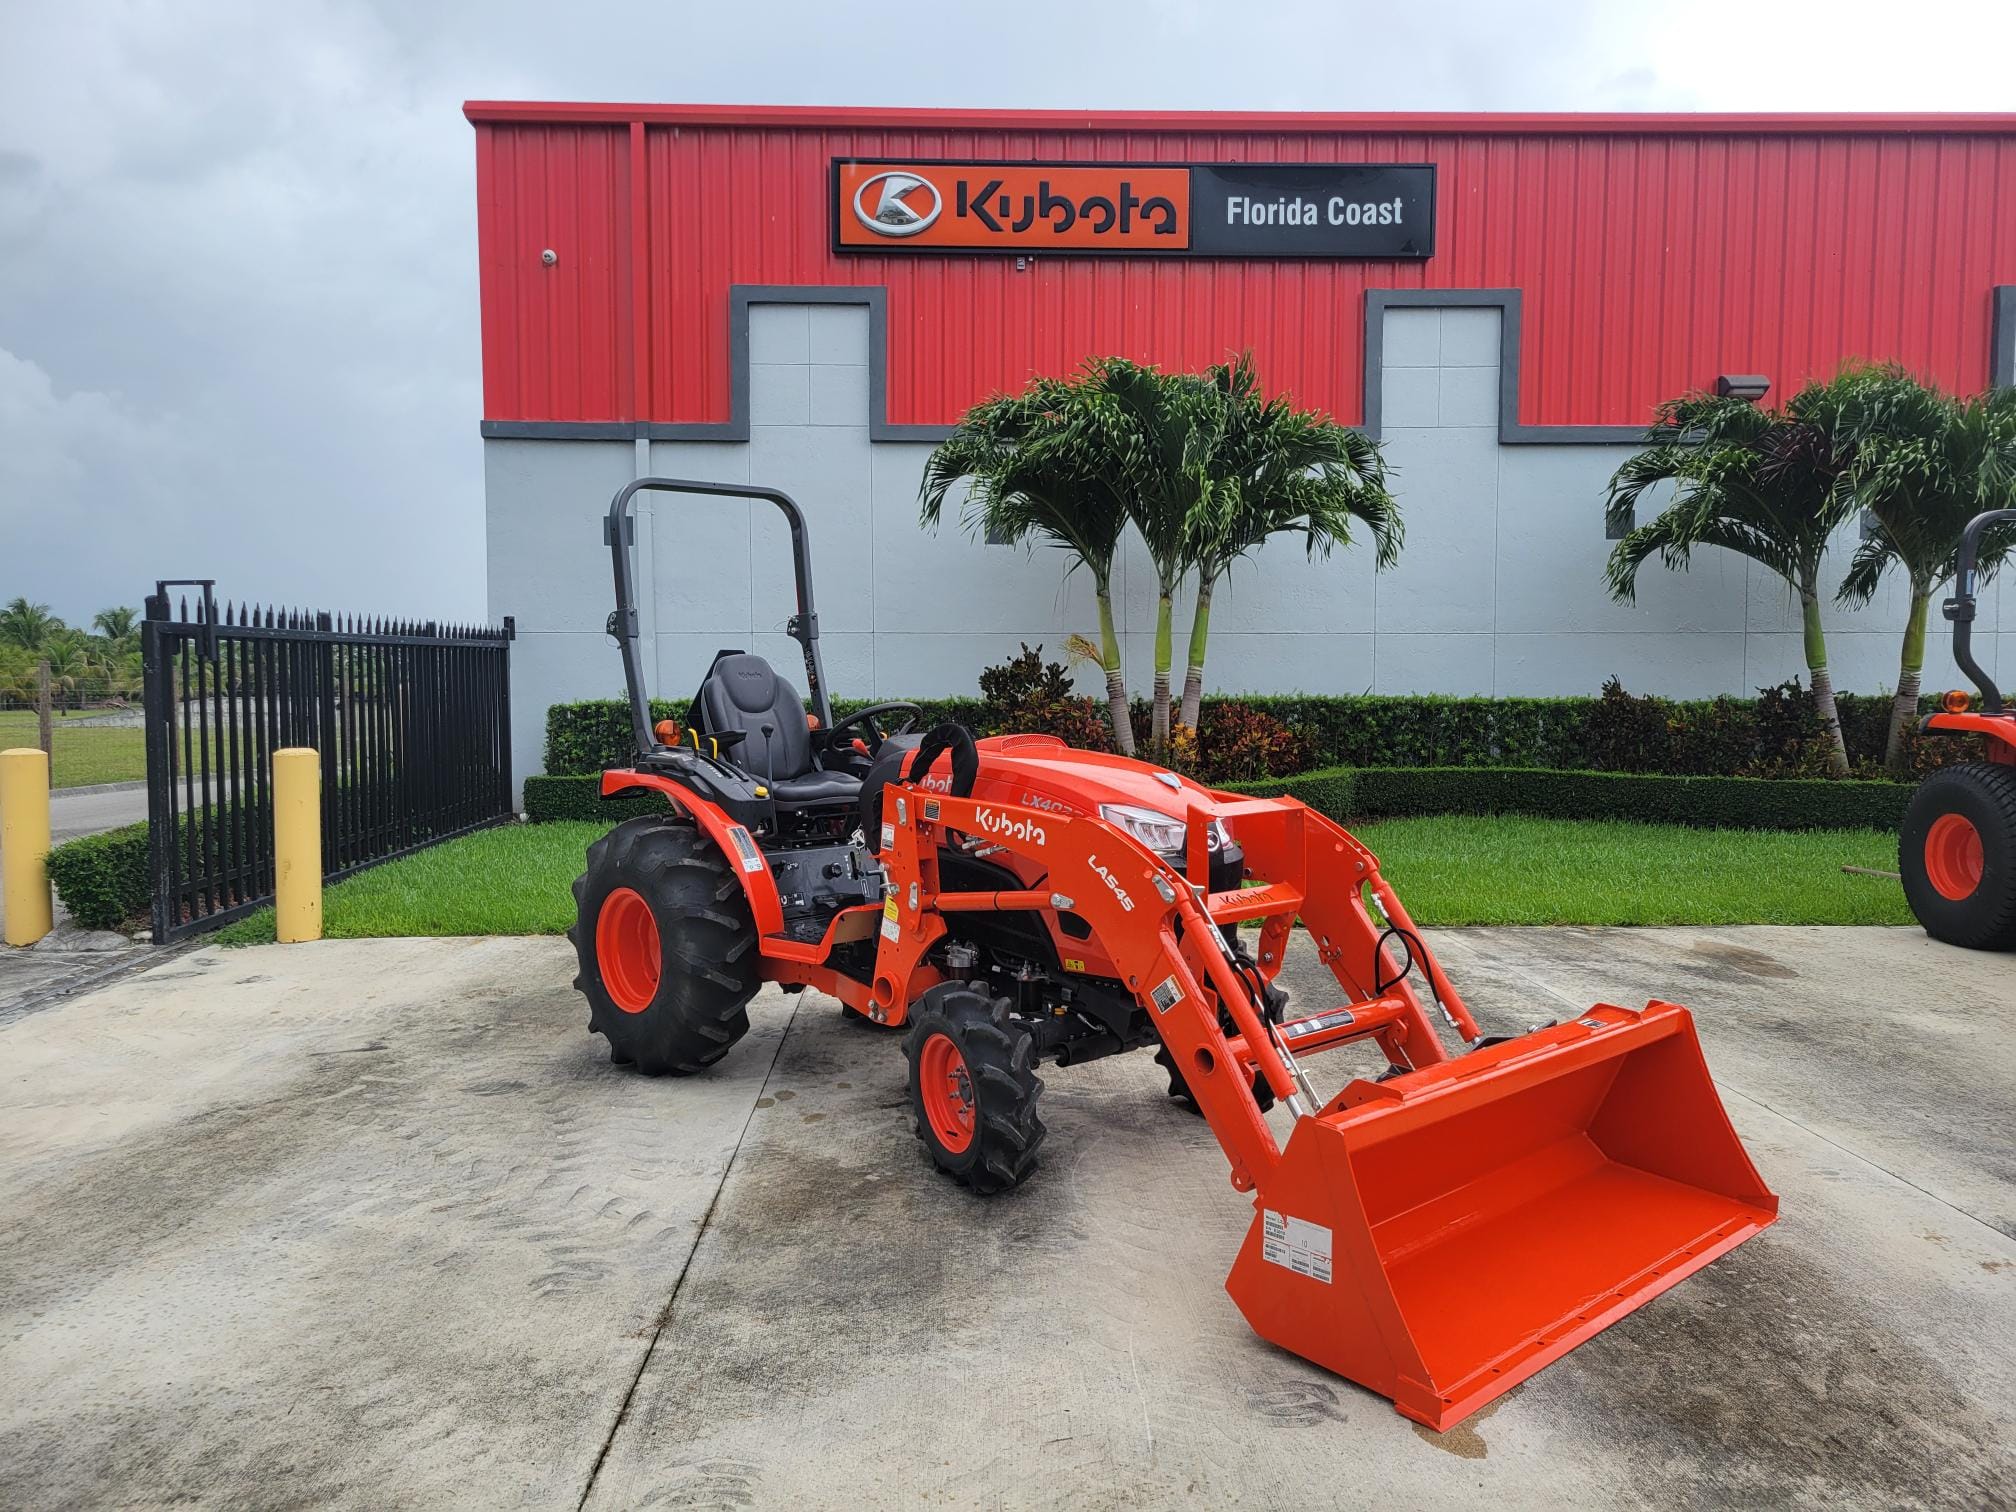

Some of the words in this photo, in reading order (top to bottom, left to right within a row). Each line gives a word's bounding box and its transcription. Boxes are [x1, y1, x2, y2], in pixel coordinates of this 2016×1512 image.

[956, 180, 1177, 234] Kubota
[1227, 196, 1318, 226] Florida
[1328, 197, 1403, 225] Coast
[975, 806, 1046, 846] Kubota
[1087, 854, 1135, 912] LA545
